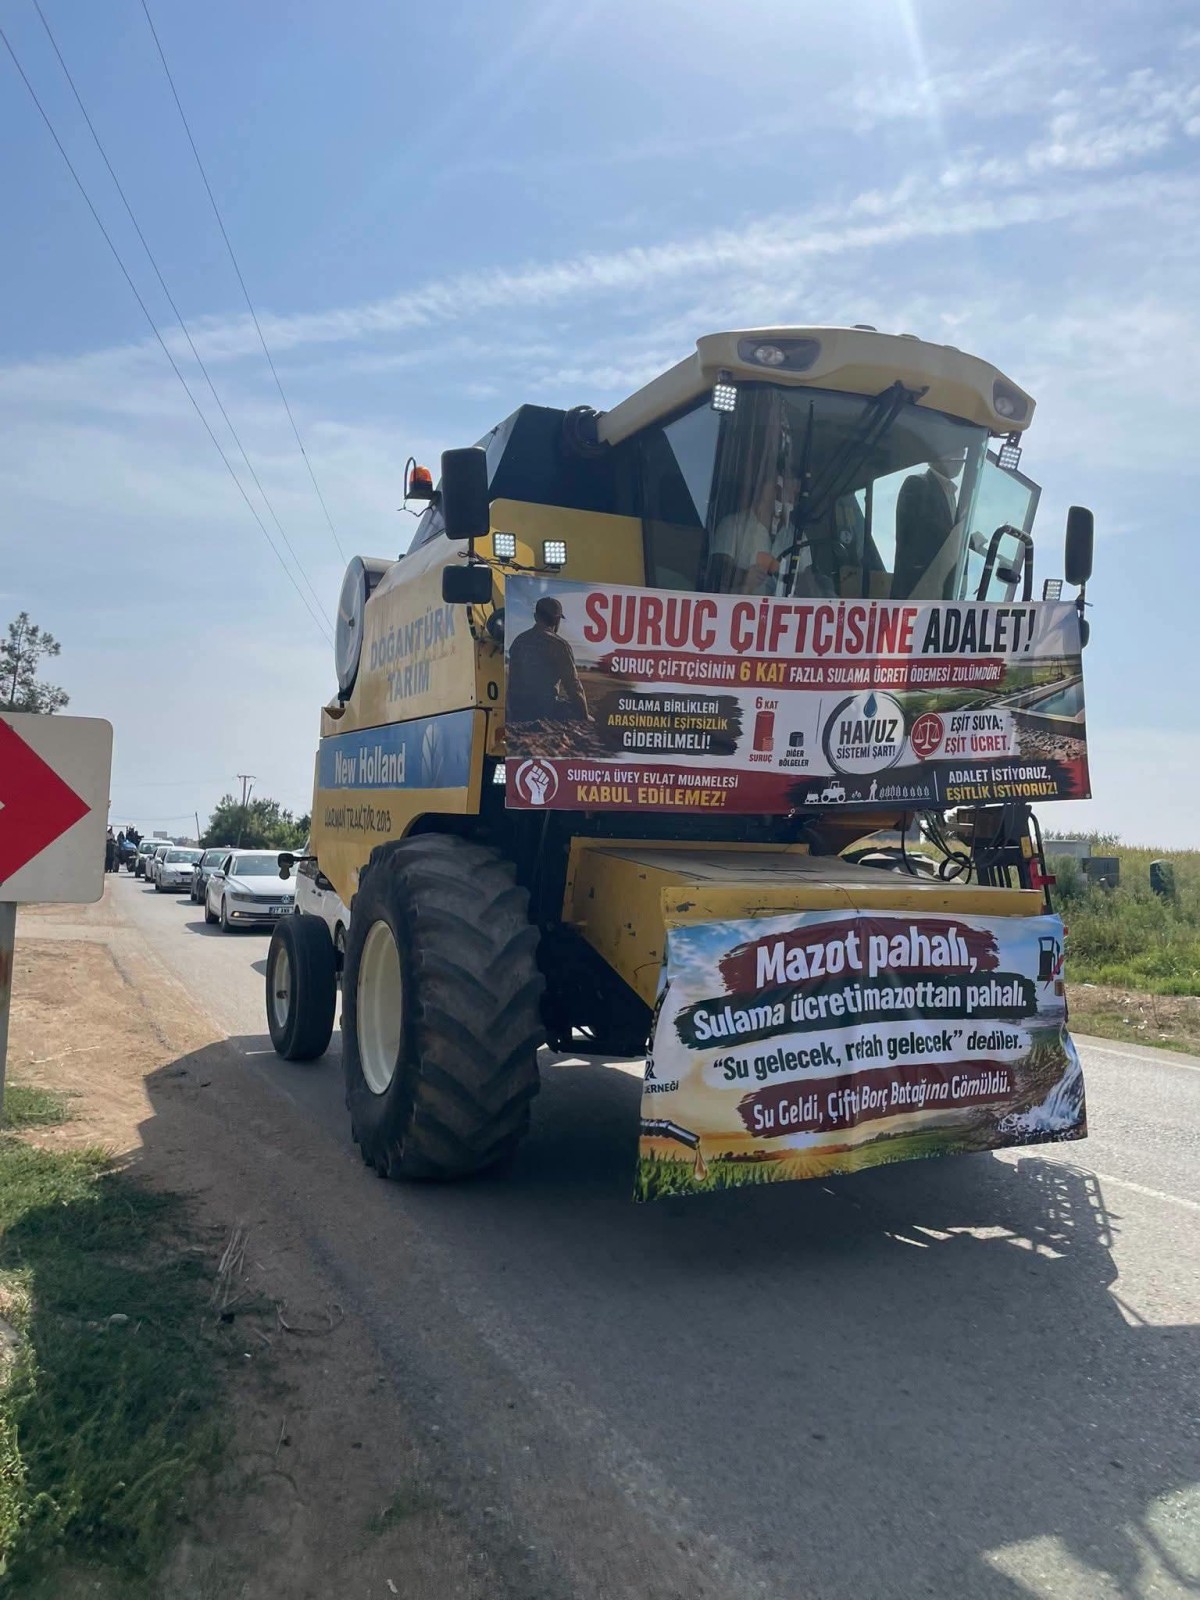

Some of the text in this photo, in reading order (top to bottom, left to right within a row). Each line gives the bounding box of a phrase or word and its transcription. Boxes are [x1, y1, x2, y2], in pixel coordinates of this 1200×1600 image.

[583, 592, 1036, 656] SURUÇ ÇİFTÇİSİNE ADALET!
[370, 604, 455, 671] DOĞANTÜRK
[611, 656, 1001, 683] SURUÇ ÇİFTÇİSİNİN 6 KAT FAZLA SULAMA ÜCRETİ ÖDEMESİ ZULÜMDÜR!
[388, 660, 430, 702] TARIM
[618, 698, 719, 714] SULAMA BİRLİKLERİ
[755, 696, 779, 710] 6 KAT
[674, 715, 728, 730] EŞİTSİZLİK
[839, 719, 898, 745] HAVUZ
[950, 714, 1004, 734] EŞİT SUYA;
[623, 729, 711, 749] GİDERİLMELİ!
[944, 733, 1010, 755] EŞİT ÜCRET.
[749, 754, 773, 763] SURUÇ
[786, 748, 805, 757] DİĞER
[836, 744, 896, 759] SİSTEMİ ŞART!
[334, 742, 406, 784] New Holland
[778, 758, 809, 767] BÖLGELER
[567, 769, 738, 788] SURUÇ'A ÜVEY EVLAT MUAMELESİ
[949, 766, 1051, 783] ADALET İSTİYORUZ,
[577, 785, 727, 806] KABUL EDİLEMEZ!
[946, 782, 1059, 802] EŞİTLİK İSTİYORUZ!
[756, 925, 977, 988] Mazot pahalı,
[693, 980, 1026, 1041] Sulama ücreti mazottan pahalı.
[753, 1042, 841, 1080] gelecek,
[845, 1034, 883, 1061] refah
[967, 1030, 1023, 1051] dediler.
[753, 1104, 774, 1130] Su
[779, 1094, 823, 1124] Geldi,
[861, 1086, 888, 1112] Borç
[890, 1078, 949, 1107] Batağına
[951, 1071, 1011, 1099] Gömüldü.
